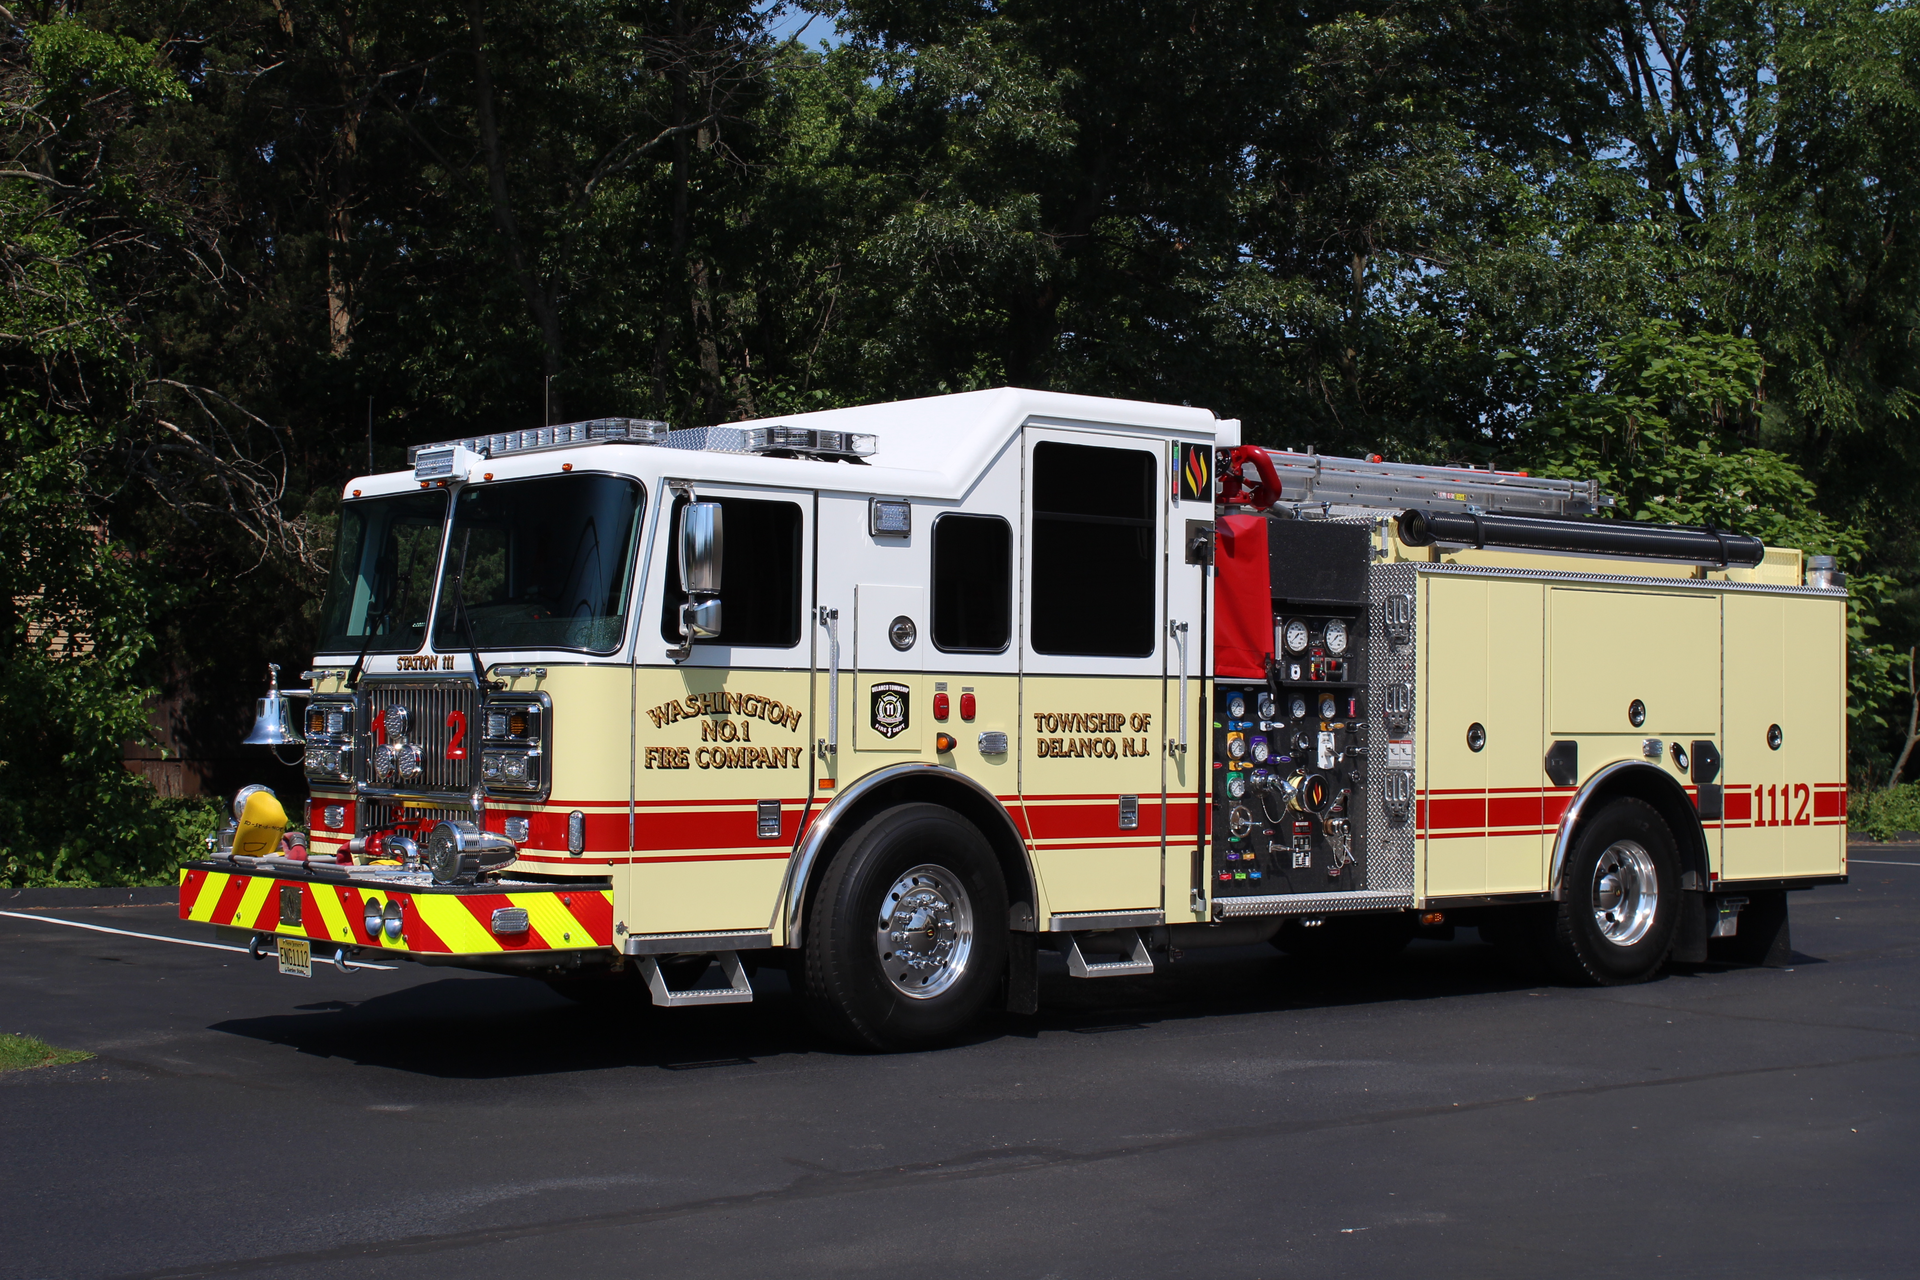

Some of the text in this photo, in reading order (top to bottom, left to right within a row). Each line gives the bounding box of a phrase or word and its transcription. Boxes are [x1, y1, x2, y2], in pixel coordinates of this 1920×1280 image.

[397, 655, 455, 671] STATION 111
[646, 691, 802, 733] WASHINGTON
[885, 704, 894, 715] 11
[875, 723, 905, 733] FIRE DEPT
[1034, 713, 1151, 733] TOWNSHIP OF
[446, 710, 466, 759] 2
[644, 746, 803, 769] FIRE COMPANY
[1037, 737, 1150, 760] DELANCO, N.J.
[1754, 783, 1810, 827] 1112
[280, 947, 309, 968] ENG1112
